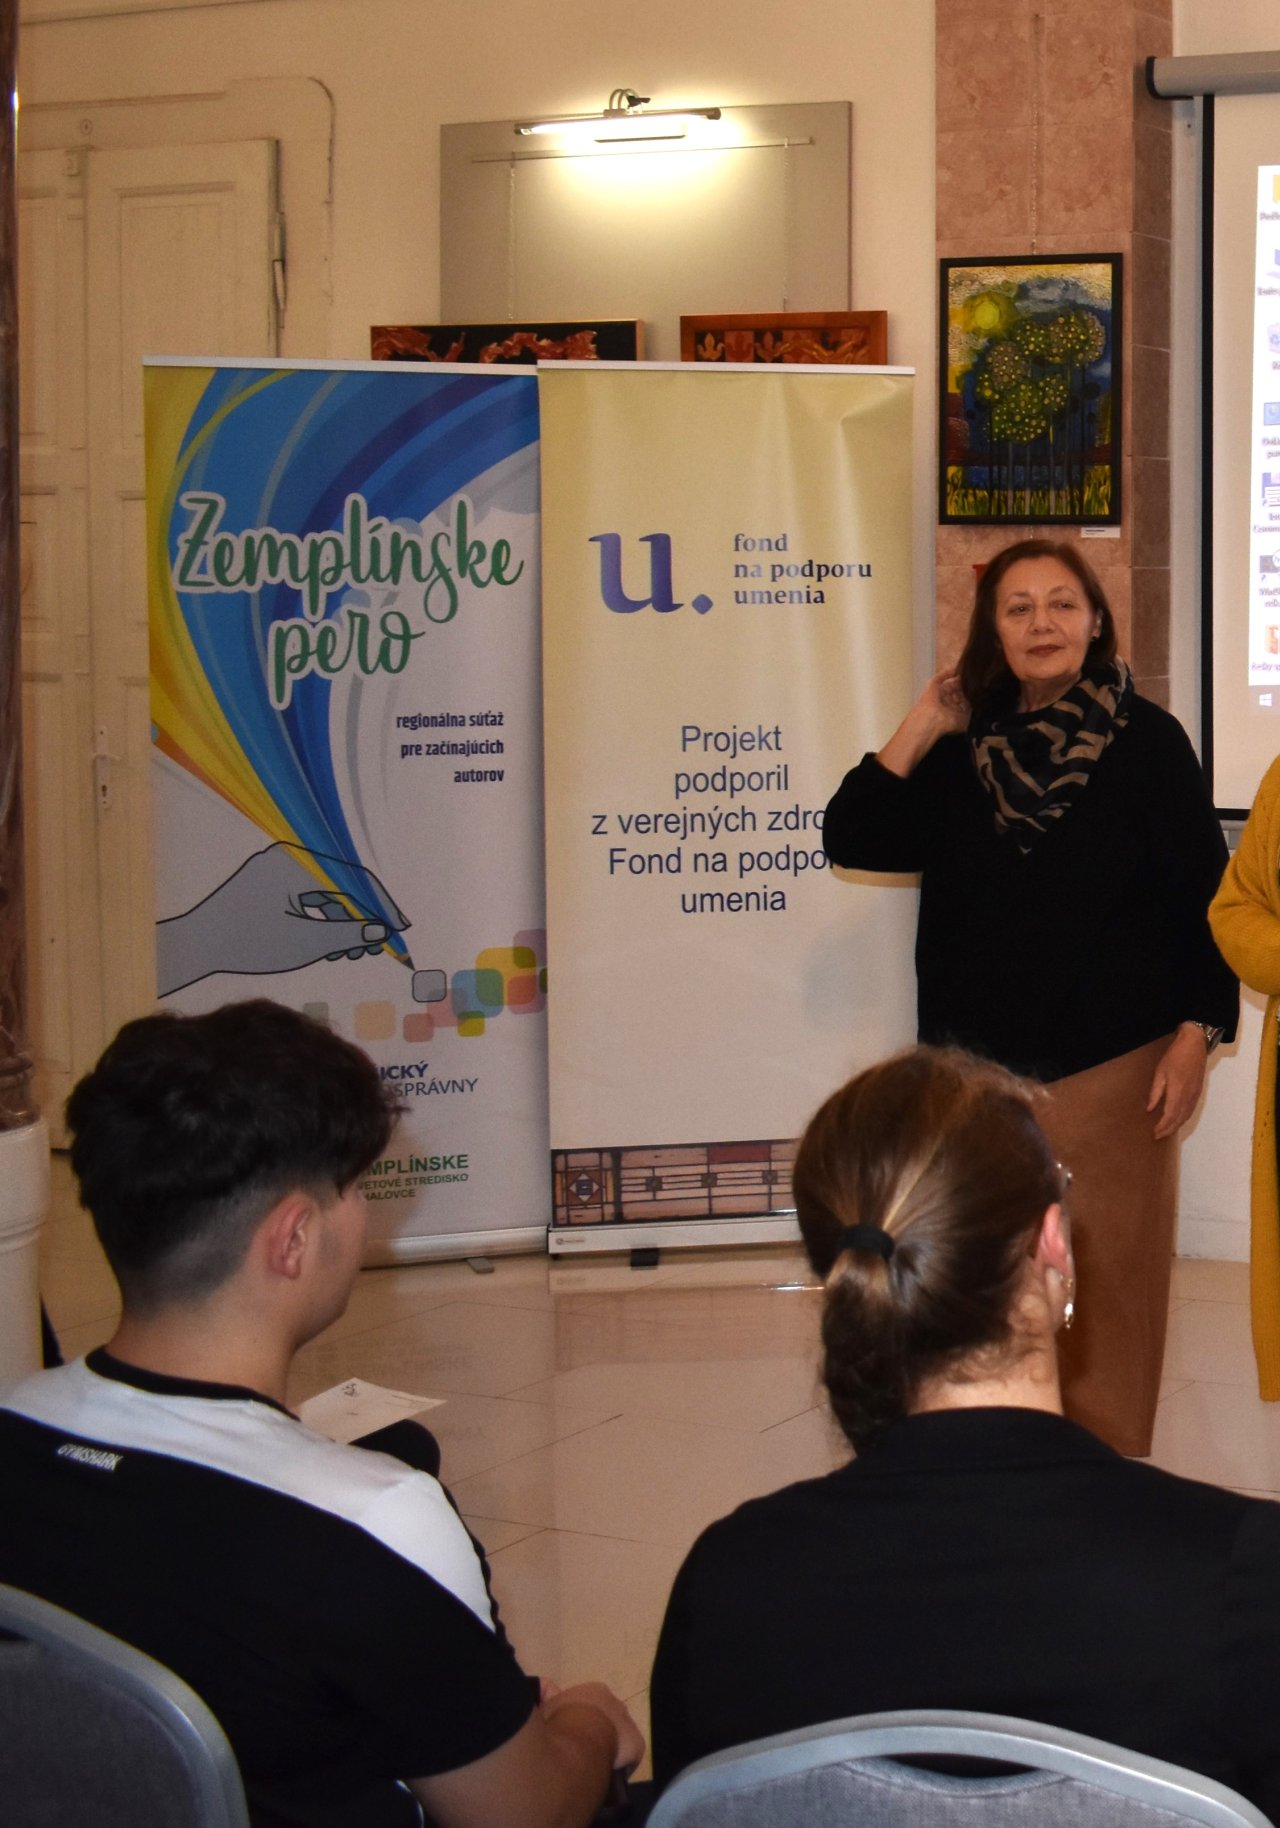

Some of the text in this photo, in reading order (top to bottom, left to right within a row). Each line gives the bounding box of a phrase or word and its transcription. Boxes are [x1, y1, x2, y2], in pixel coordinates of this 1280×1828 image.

[733, 533, 788, 552] fond
[177, 497, 525, 624] Zemplínske
[733, 559, 872, 583] na podporu
[733, 585, 826, 605] umenia
[273, 608, 426, 705] pero
[396, 709, 504, 731] regionálna súťaž
[400, 739, 504, 759] pre začínajúcich
[681, 725, 782, 759] Projekt
[453, 769, 505, 784] autorov
[674, 765, 790, 800] podporil
[592, 804, 825, 840] z verejných zdro
[608, 845, 682, 875] Fond
[693, 851, 728, 874] na
[681, 884, 787, 914] umenia
[379, 1061, 430, 1080] ICKÝ
[390, 1077, 479, 1097] SPRÁVNY
[367, 1154, 469, 1176] MPLÍNSKE
[405, 1173, 469, 1187] STREDISKO
